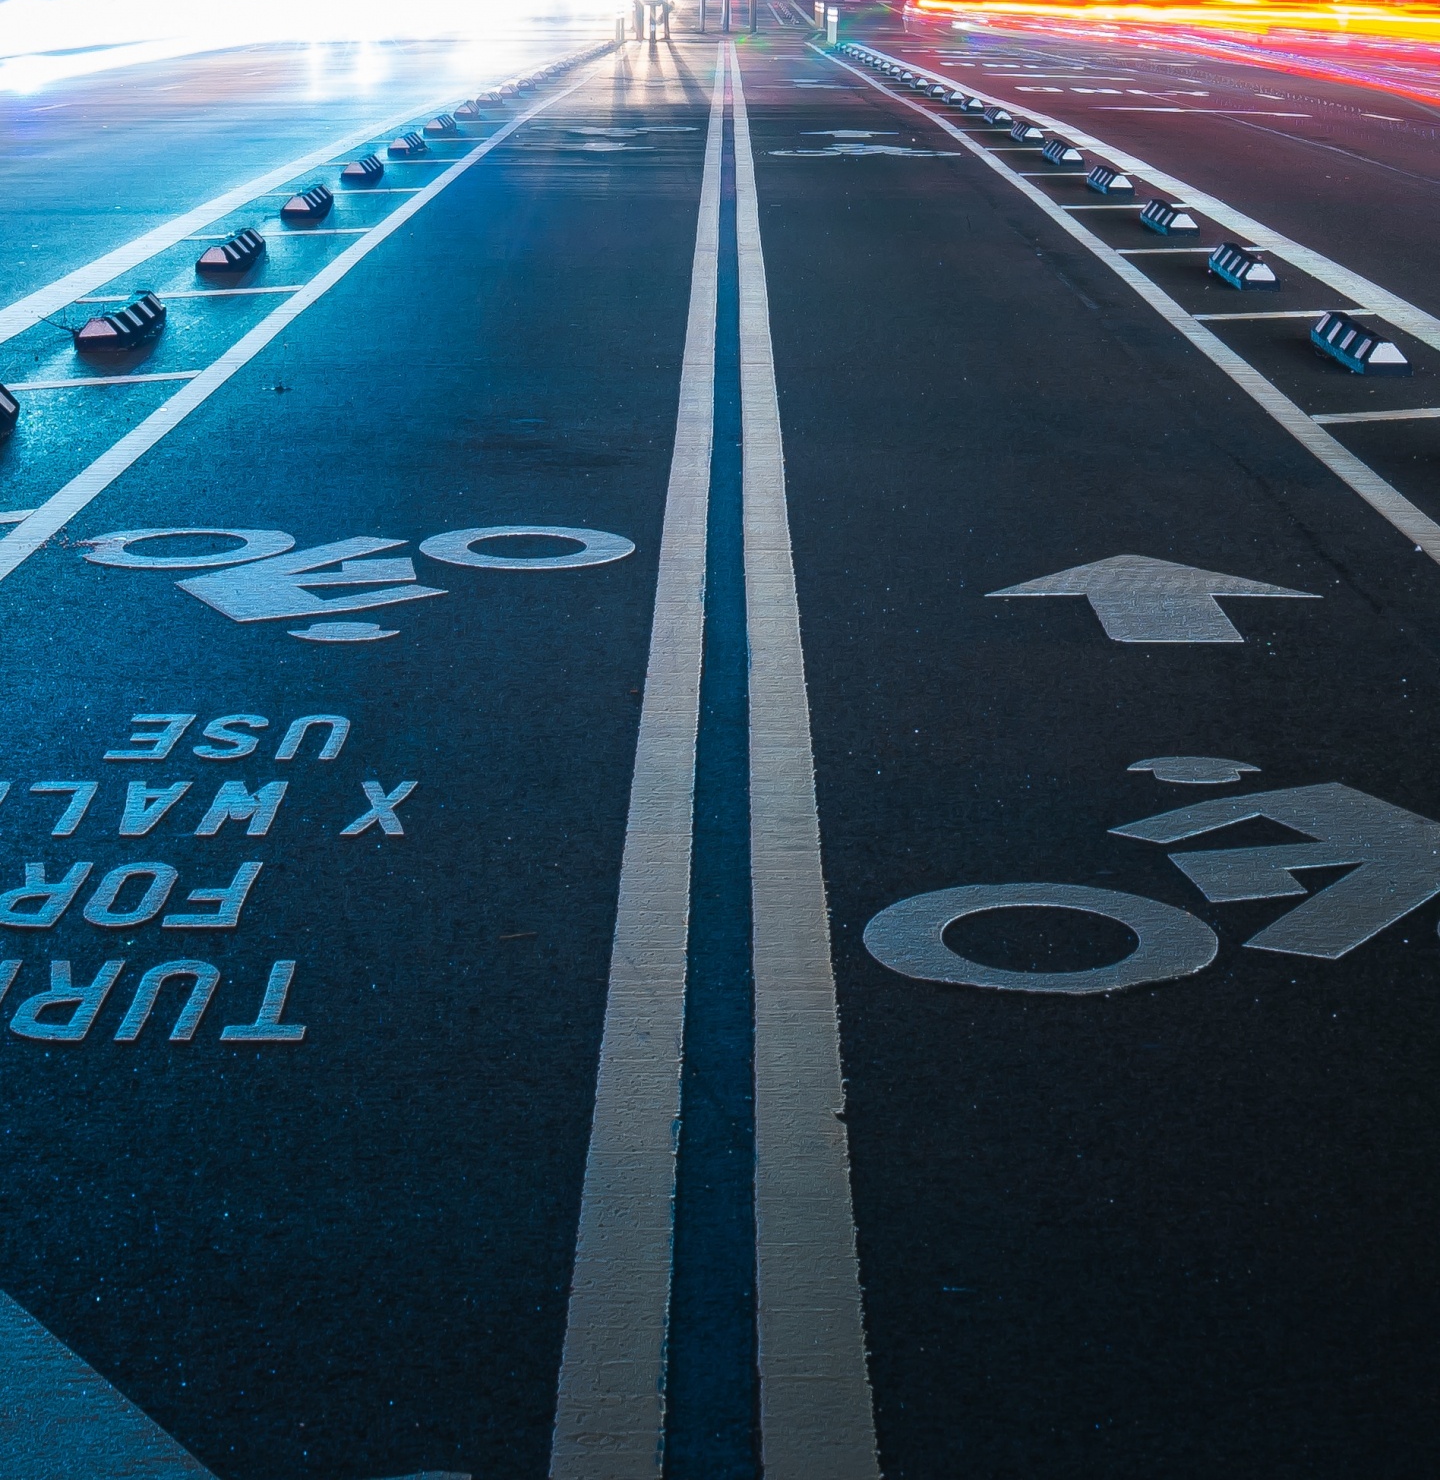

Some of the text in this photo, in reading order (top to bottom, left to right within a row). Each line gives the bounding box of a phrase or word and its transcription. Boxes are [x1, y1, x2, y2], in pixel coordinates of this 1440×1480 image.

[103, 713, 351, 760] USE
[0, 781, 419, 835] X WAL
[0, 861, 263, 928] FOR
